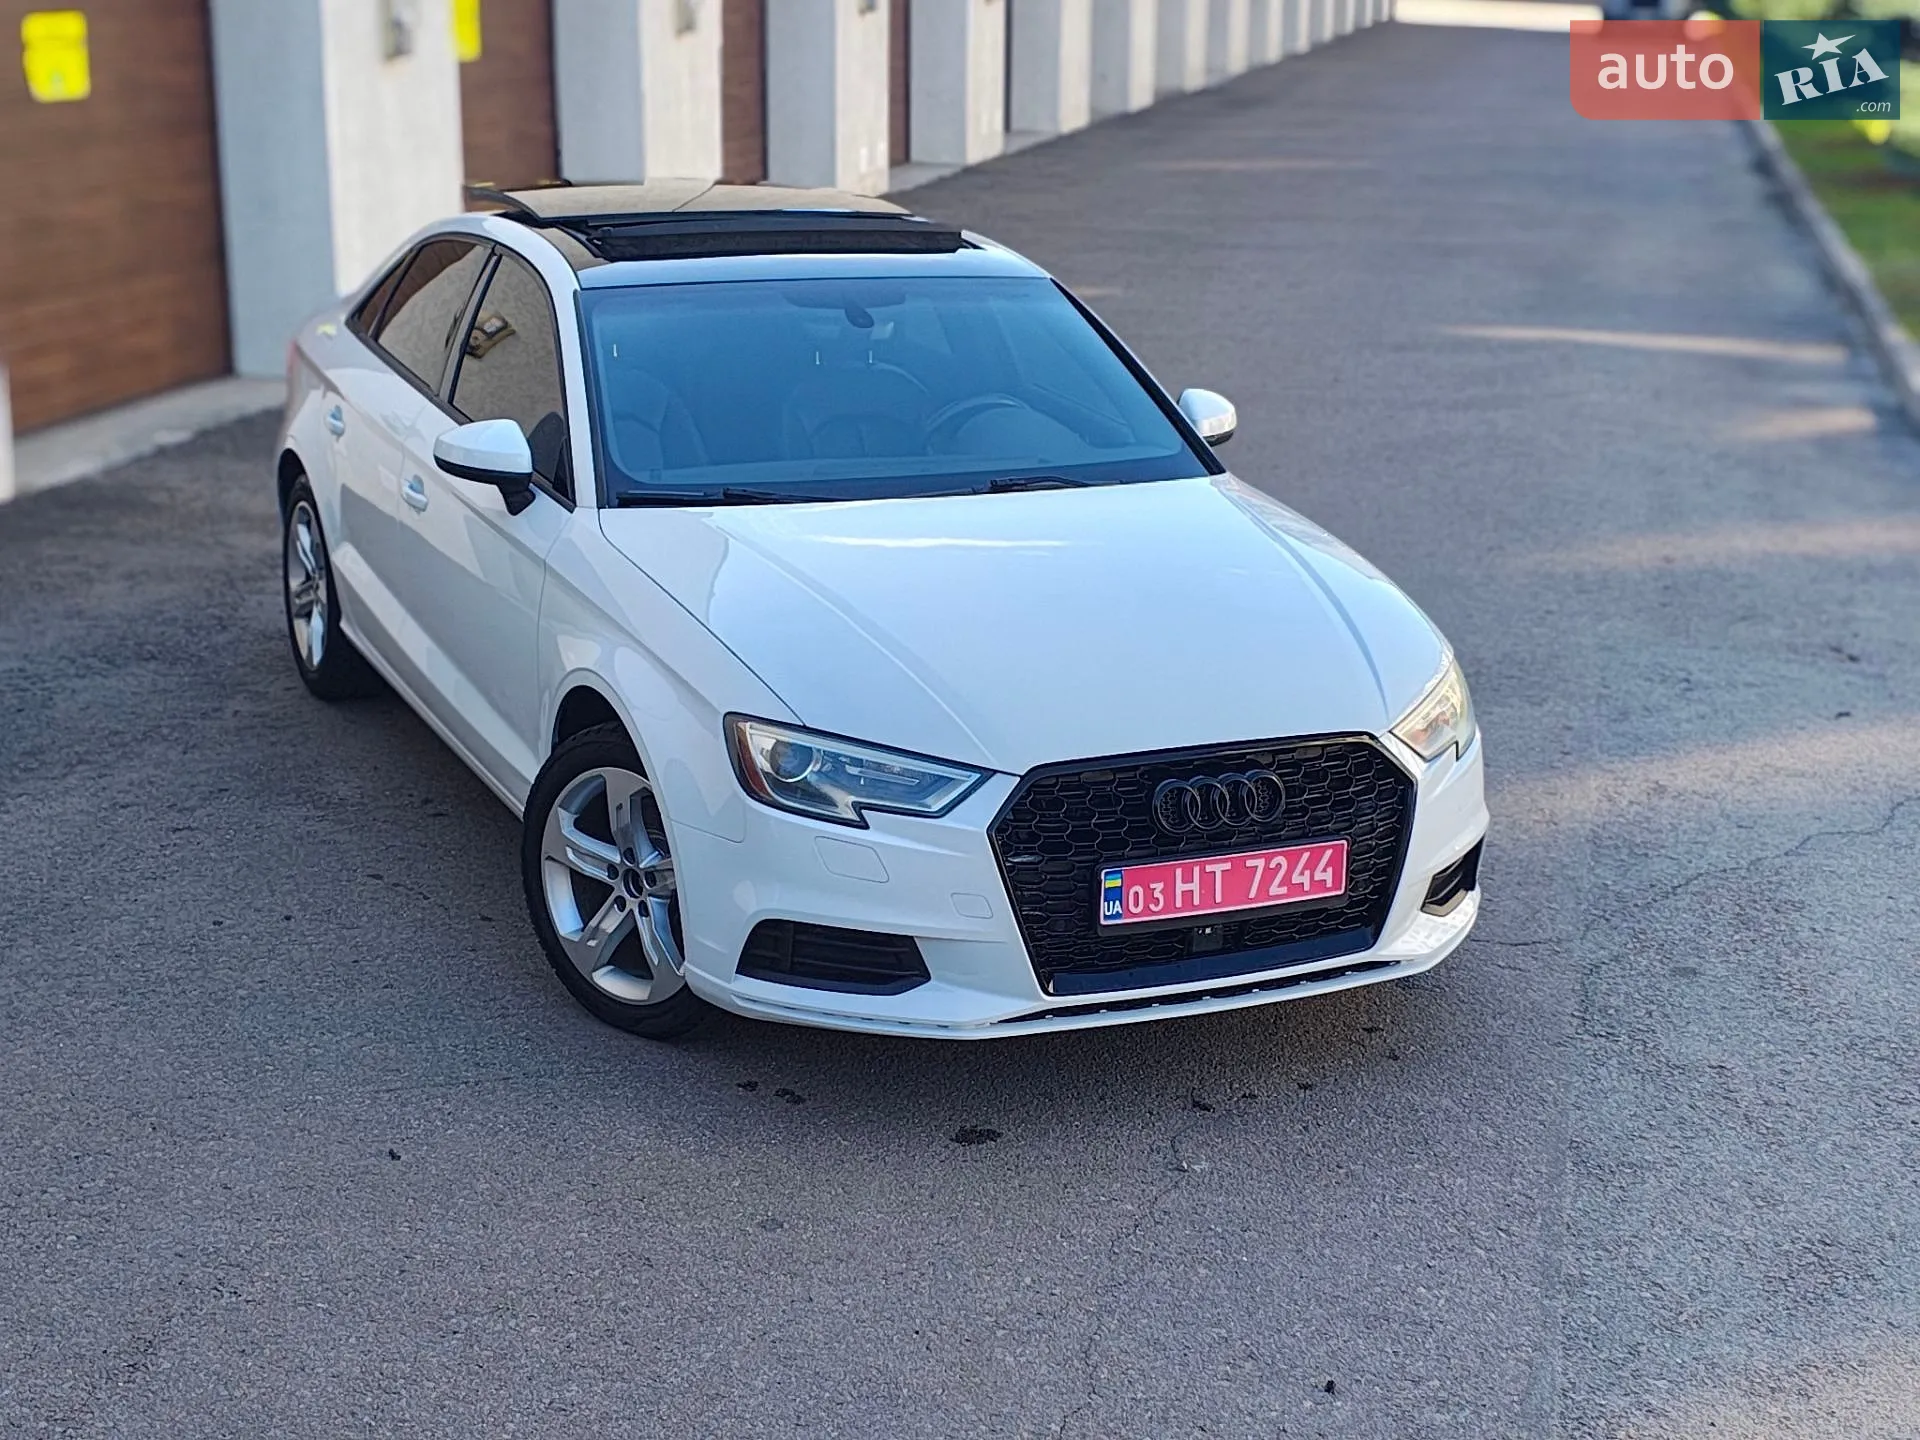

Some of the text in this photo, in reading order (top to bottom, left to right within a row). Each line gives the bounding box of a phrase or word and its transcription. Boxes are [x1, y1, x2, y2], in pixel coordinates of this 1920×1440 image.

[1127, 848, 1333, 914] 03 HT 7244
[1104, 900, 1123, 916] UA
